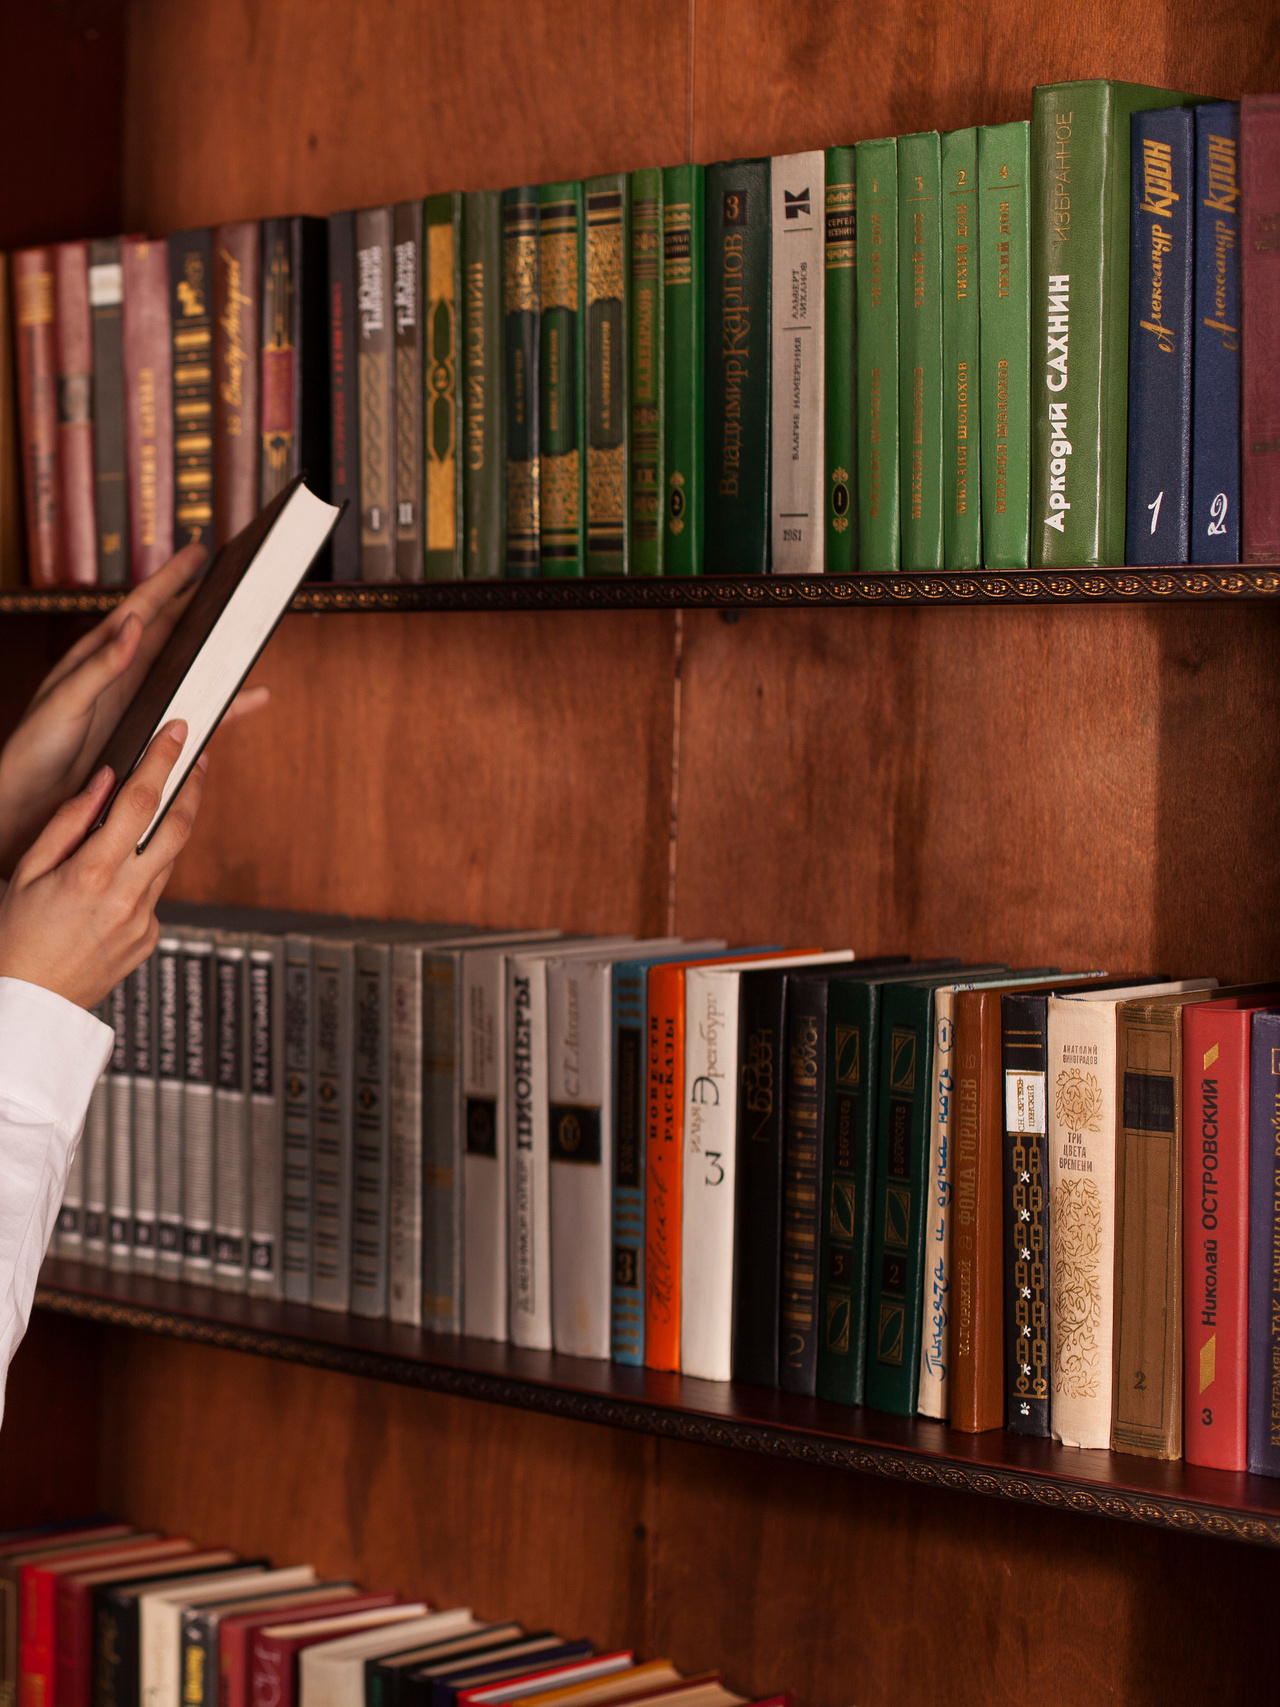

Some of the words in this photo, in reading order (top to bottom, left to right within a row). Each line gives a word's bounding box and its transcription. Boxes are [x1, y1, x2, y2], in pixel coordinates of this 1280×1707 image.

[873, 179, 878, 193] 1
[915, 176, 924, 191] 3
[957, 170, 967, 185] 2
[999, 164, 1010, 180] 4
[1054, 111, 1073, 243] ИЗБРАННОЕ
[726, 196, 739, 219] 3
[871, 214, 883, 246] ДОН
[914, 213, 926, 246] ДОН
[957, 205, 969, 237] ДОН
[998, 202, 1012, 236] ДОН
[870, 250, 883, 307] ТИХИЙ
[911, 250, 925, 308] ТИХИЙ
[954, 242, 969, 300] ТИХИЙ
[996, 241, 1011, 299] ТИХИЙ
[1140, 225, 1175, 352] Александр
[1204, 221, 1240, 351] Александр
[1046, 274, 1070, 392] САХНИН
[870, 368, 882, 444] ШОЛОХОВ
[912, 367, 925, 444] ШОЛОХОВ
[957, 362, 969, 439] ШОЛОХОВ
[997, 359, 1010, 438] ШОЛОХОВ
[719, 359, 749, 498] Владимир
[870, 449, 881, 517] МИХАИЛ
[911, 449, 923, 519] МИХАИЛ
[956, 445, 968, 515] МИХАИЛ
[995, 444, 1009, 514] МИХАИЛ
[1044, 402, 1072, 533] Аркадий
[783, 528, 802, 542] 1981
[1148, 492, 1163, 535] 1
[1208, 492, 1228, 536] 2
[514, 976, 533, 1151] ПИОНЕРЫ
[650, 1015, 658, 1139] ПОВЕСТИ
[691, 992, 721, 1106] Эренбург
[1062, 1044, 1099, 1055] АНАТОЛИЙ
[1062, 1054, 1099, 1066] ВИНОГРАДОВ
[664, 1016, 675, 1141] РАССКАЗЫ
[937, 1069, 954, 1124] ночь
[960, 1078, 977, 1162] ГОРДЕЕВ
[1067, 1132, 1082, 1143] ТРИ
[705, 1152, 724, 1186] 3
[934, 1136, 952, 1208] одна
[1059, 1157, 1093, 1172] ВРЕМЕНИ
[1063, 1145, 1087, 1158] ЦВЕТА
[1200, 1079, 1219, 1231] ОСТРОВСКИЙ
[960, 1168, 976, 1225] ФОМА
[934, 1218, 945, 1242] и
[834, 1255, 845, 1275] 3
[889, 1265, 899, 1283] 2
[1202, 1239, 1218, 1327] Николай
[926, 1257, 949, 1382] Тысяча
[958, 1260, 972, 1356] М.ГОРЬКИЙ
[788, 1333, 805, 1368] 2
[1133, 1371, 1147, 1390] 2
[1202, 1408, 1213, 1426] 3
